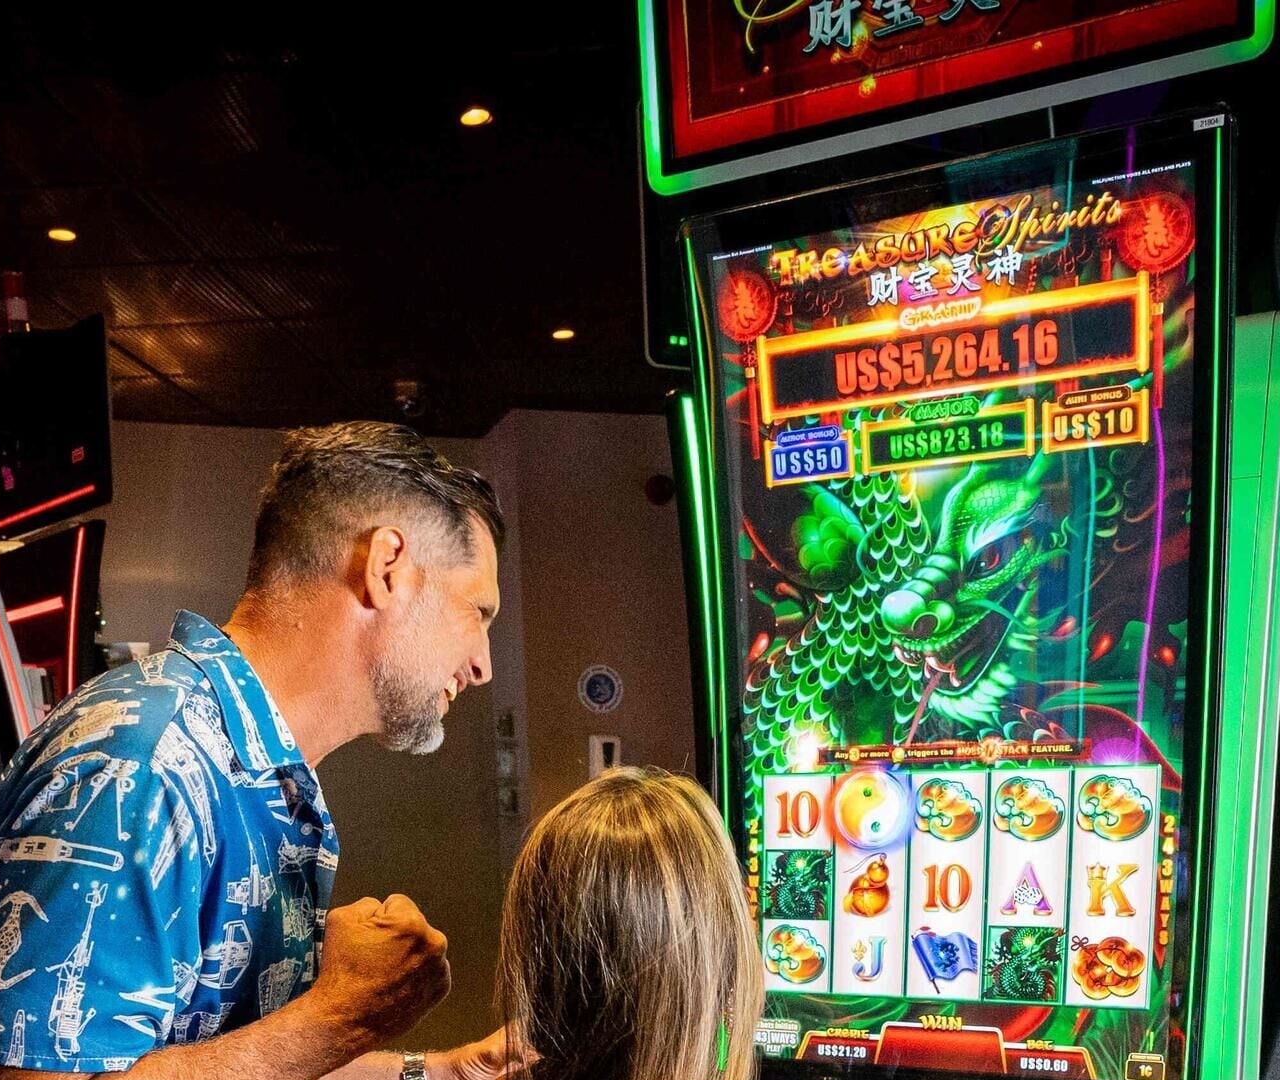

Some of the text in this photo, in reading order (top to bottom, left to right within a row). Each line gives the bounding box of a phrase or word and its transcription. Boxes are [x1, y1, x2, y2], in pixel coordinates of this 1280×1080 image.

[772, 191, 1122, 286] TREASURE Spirits
[867, 246, 1024, 306] 财宝灵神
[835, 319, 1058, 394] US$5,264.16
[916, 398, 975, 420] MAJOR
[1054, 407, 1133, 442] US$10
[889, 422, 1004, 460] US$823.18
[774, 446, 842, 477] US$50
[775, 790, 821, 838] 10
[923, 864, 973, 912] 10
[1086, 862, 1140, 917] K
[919, 1015, 963, 1032] WIN
[817, 1043, 867, 1058] US$21.20
[1020, 1057, 1069, 1073] US$0.60
